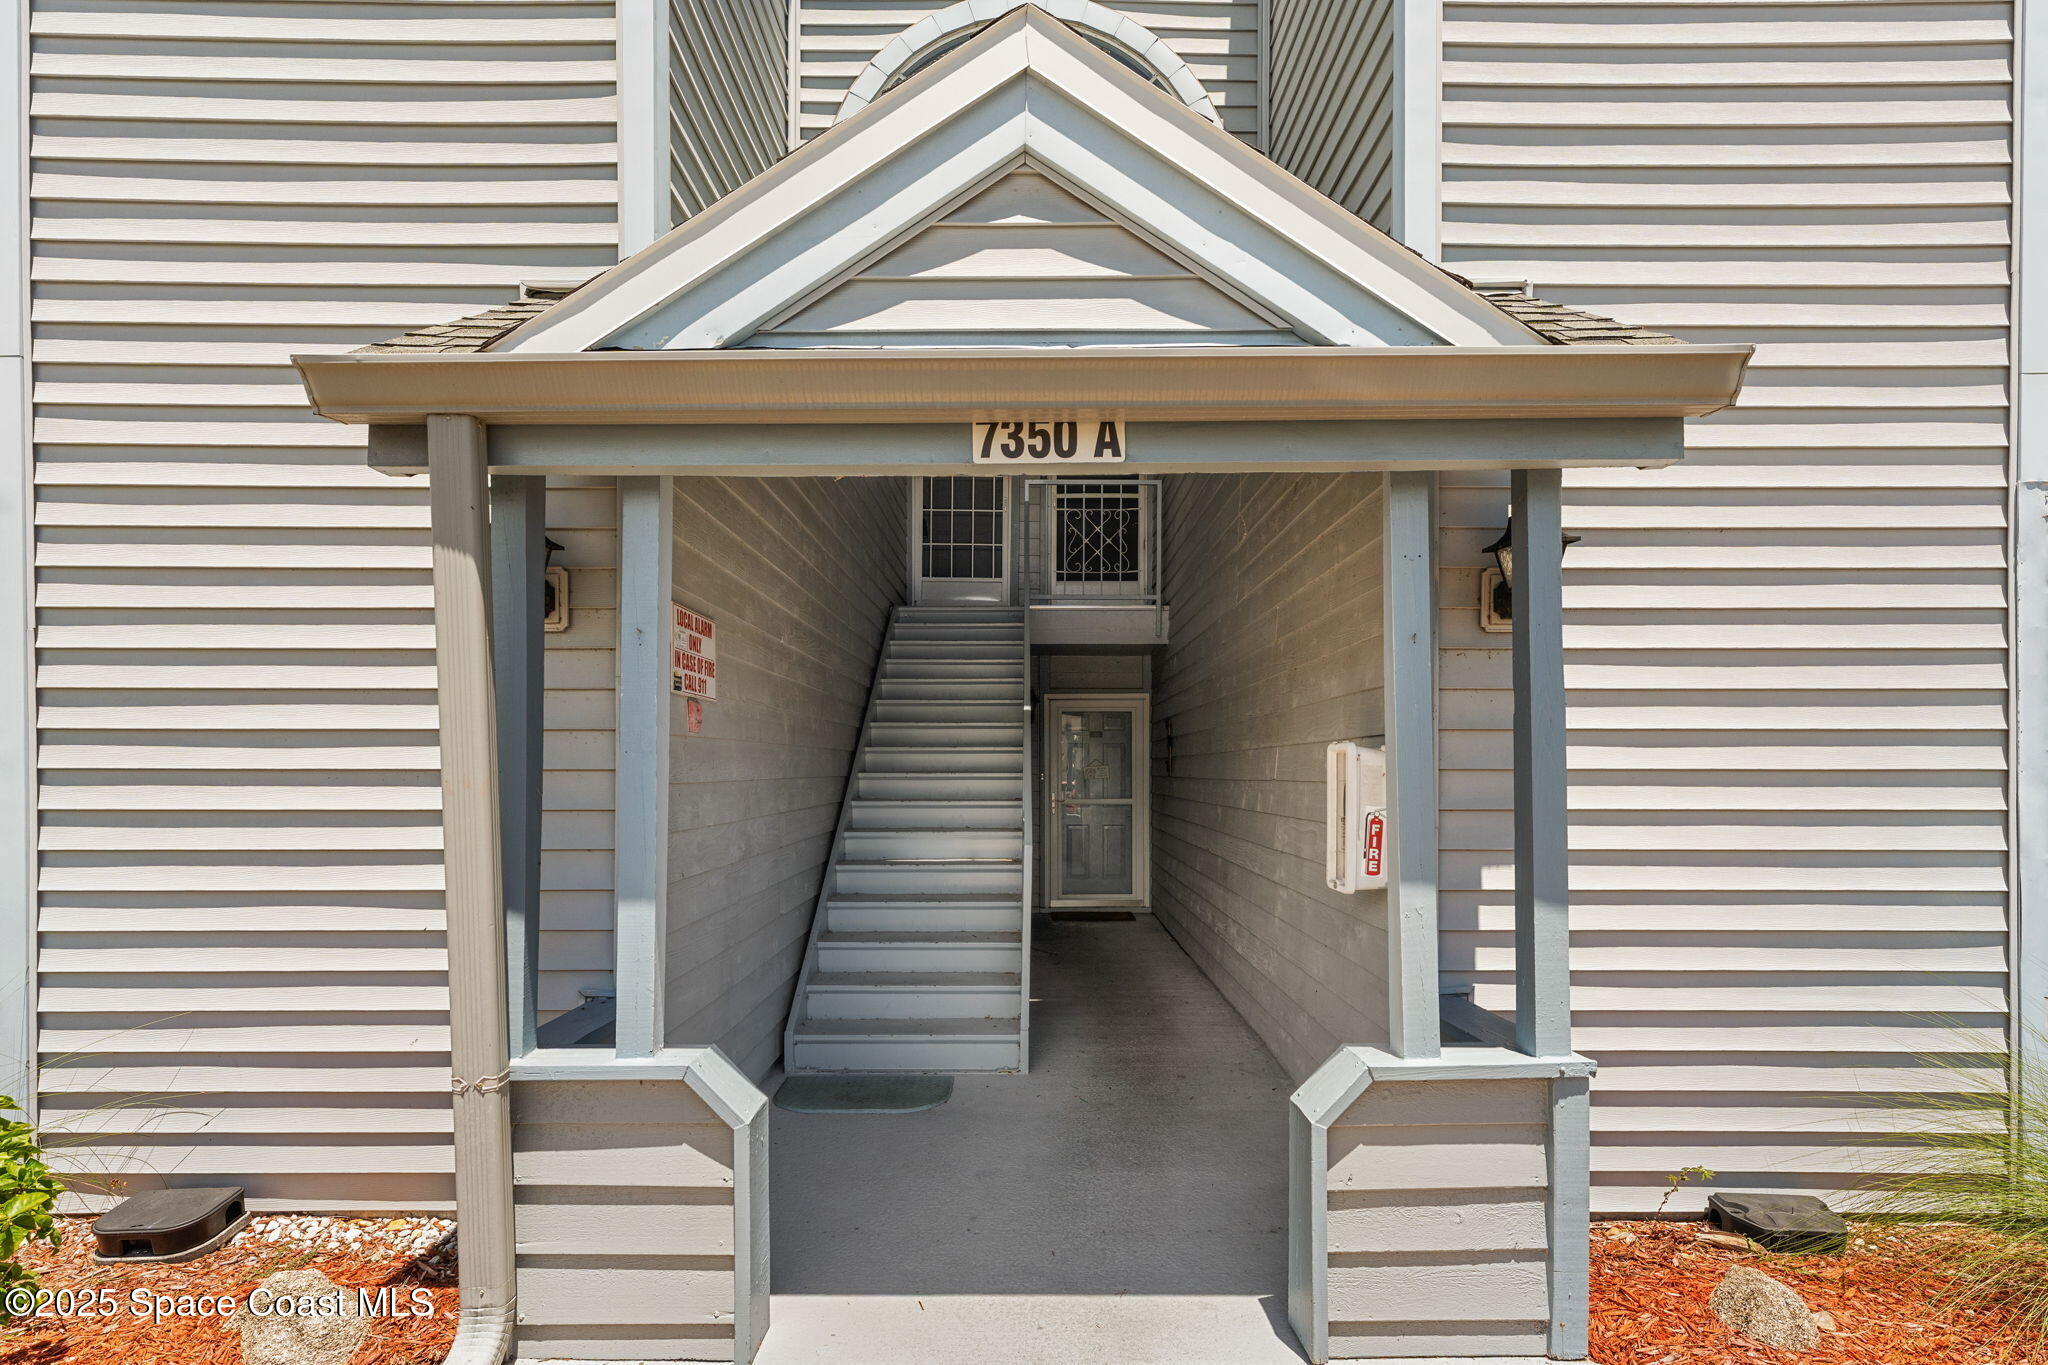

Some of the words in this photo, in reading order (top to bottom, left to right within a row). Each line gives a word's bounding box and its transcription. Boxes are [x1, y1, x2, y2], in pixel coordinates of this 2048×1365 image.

[975, 421, 1078, 459] 7350
[1093, 421, 1122, 458] A
[676, 608, 694, 632] LOCAL
[695, 616, 713, 639] ALARM
[688, 633, 702, 654] ONLY
[674, 649, 681, 668] IN
[682, 652, 696, 673] CASE
[697, 656, 704, 675] OF
[704, 659, 715, 679] FIRE
[684, 673, 697, 692] CALL
[697, 677, 707, 695] 911
[1368, 824, 1381, 872] FIRE
